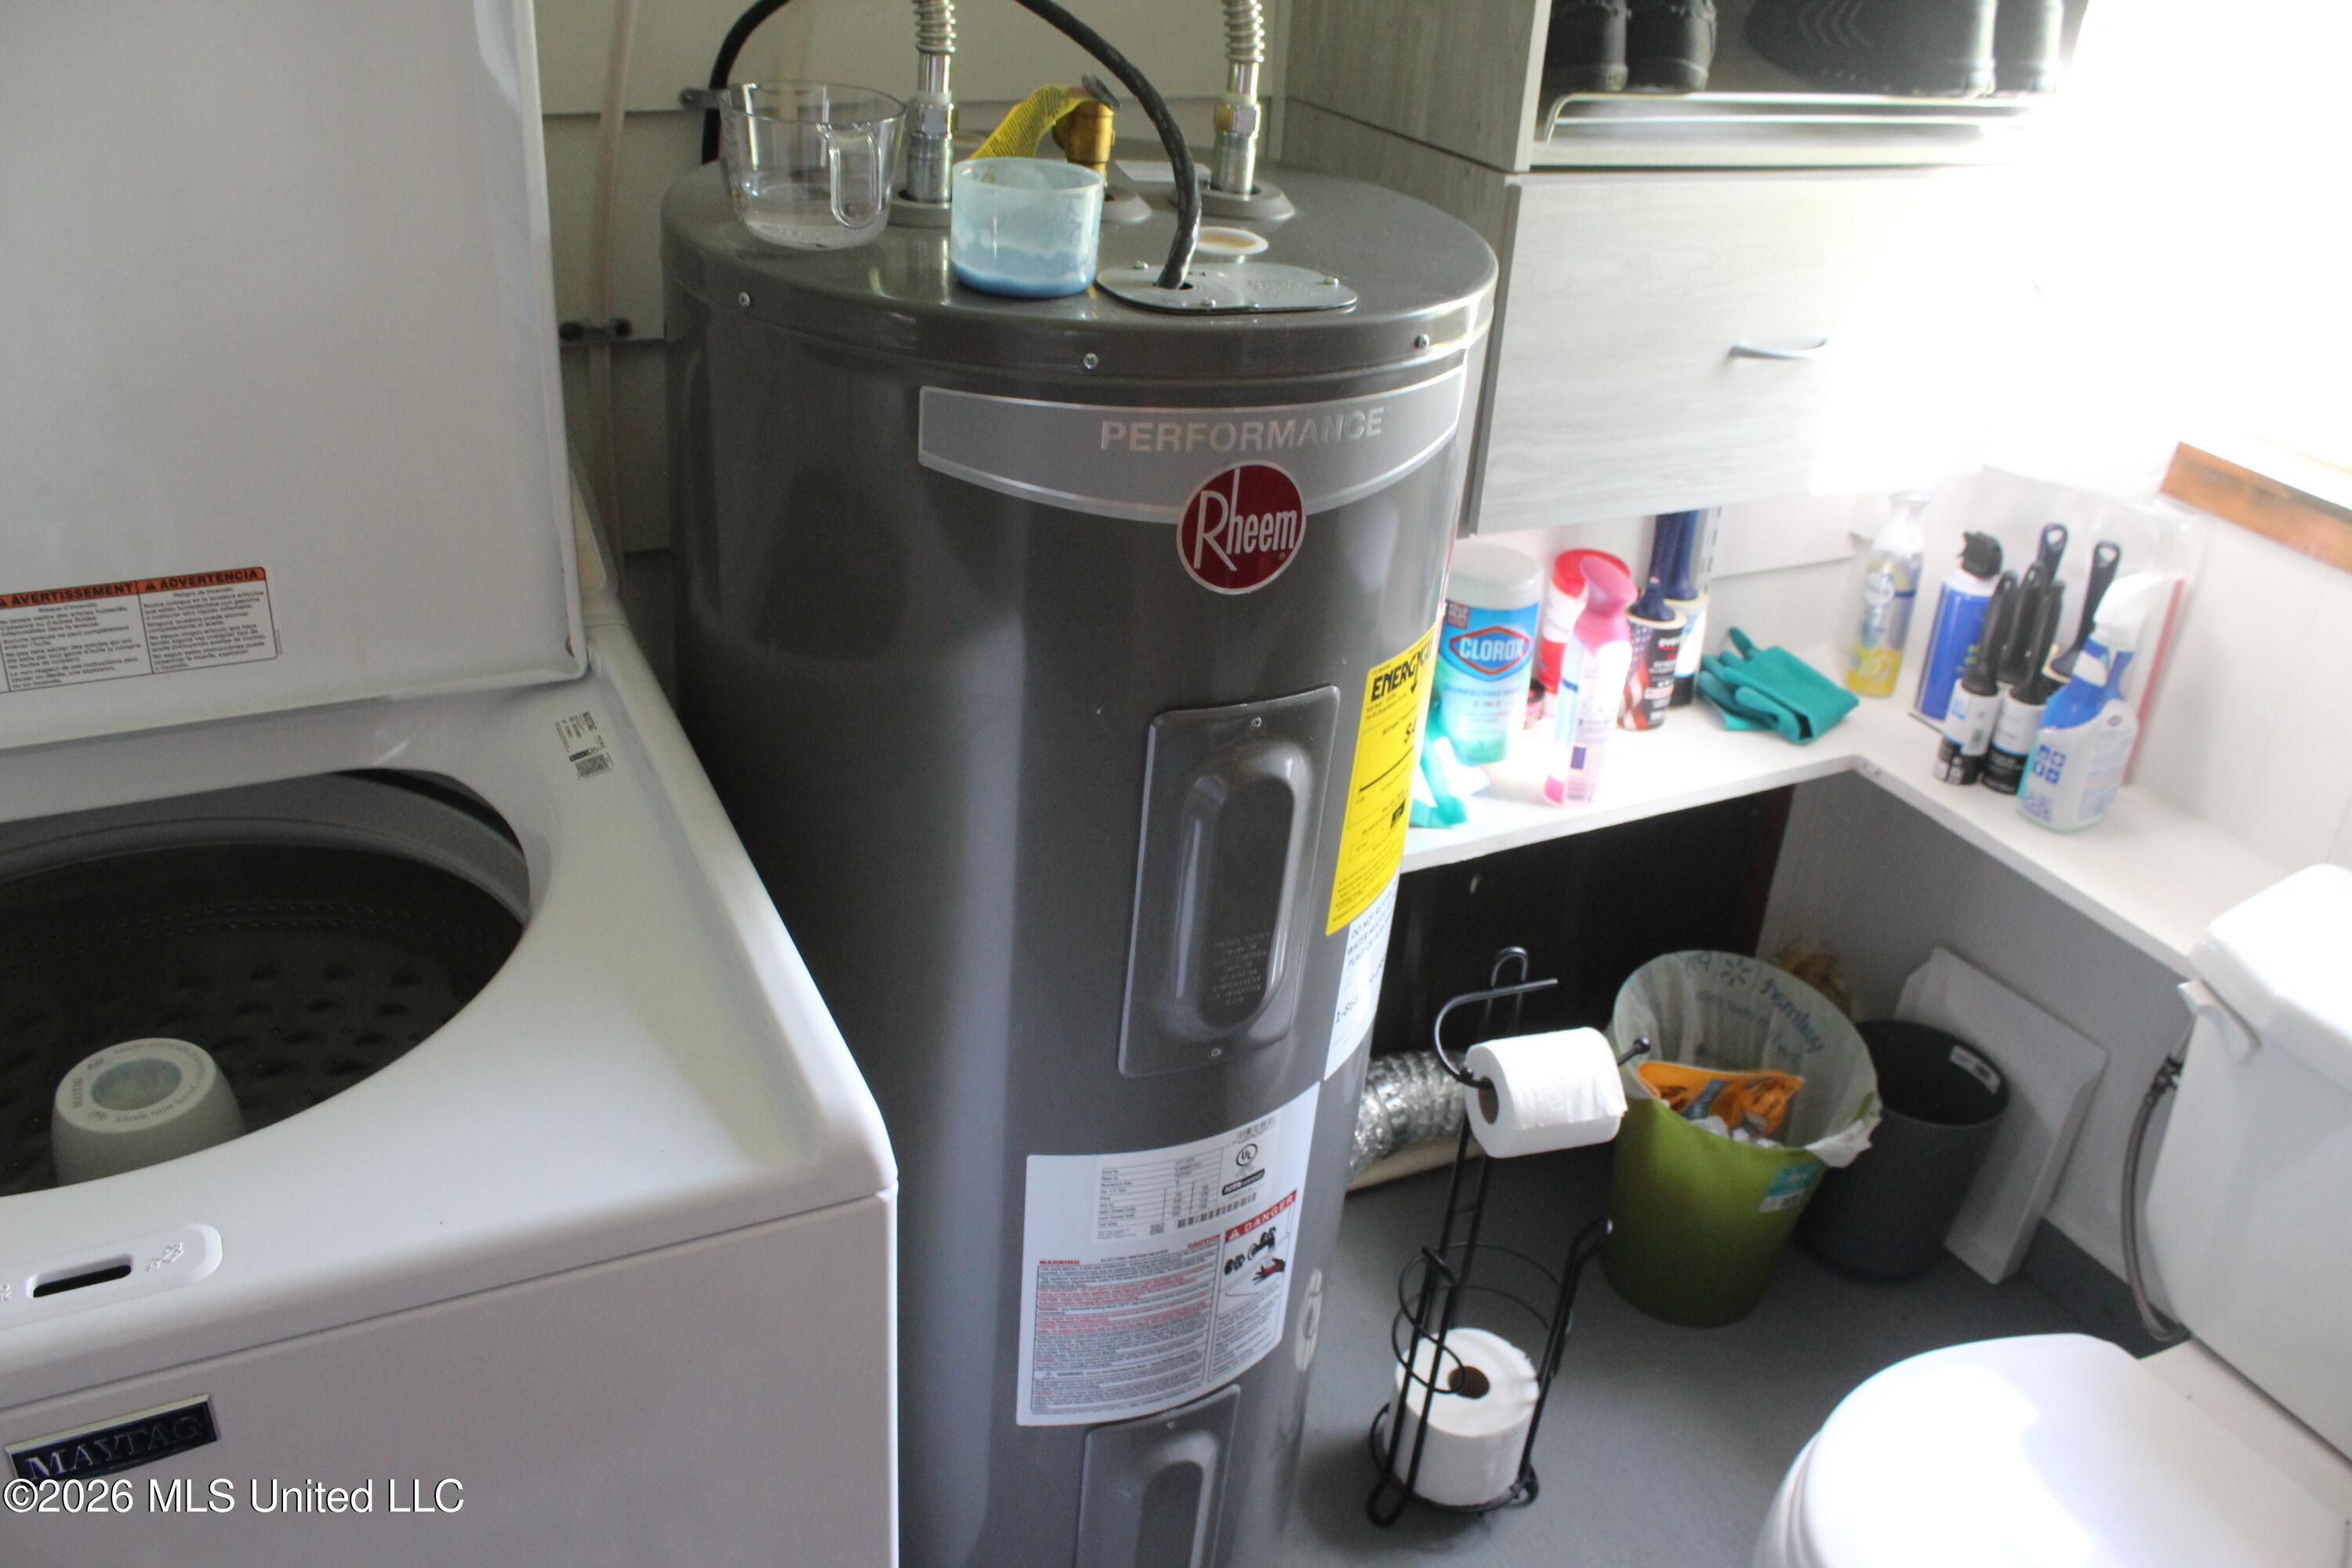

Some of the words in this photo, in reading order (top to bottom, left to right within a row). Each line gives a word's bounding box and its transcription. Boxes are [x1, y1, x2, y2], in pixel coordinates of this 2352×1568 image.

[1101, 405, 1385, 453] PERFORMANCE
[1192, 464, 1298, 572] Rheem
[11, 583, 133, 606] AVERTISSEMENT
[159, 568, 259, 590] ADVERTENCIA
[1458, 636, 1526, 662] CLOROX
[1243, 1194, 1294, 1233] DANGER
[1187, 1233, 1221, 1250] CAUTION
[24, 1416, 203, 1479] MAYTAG
